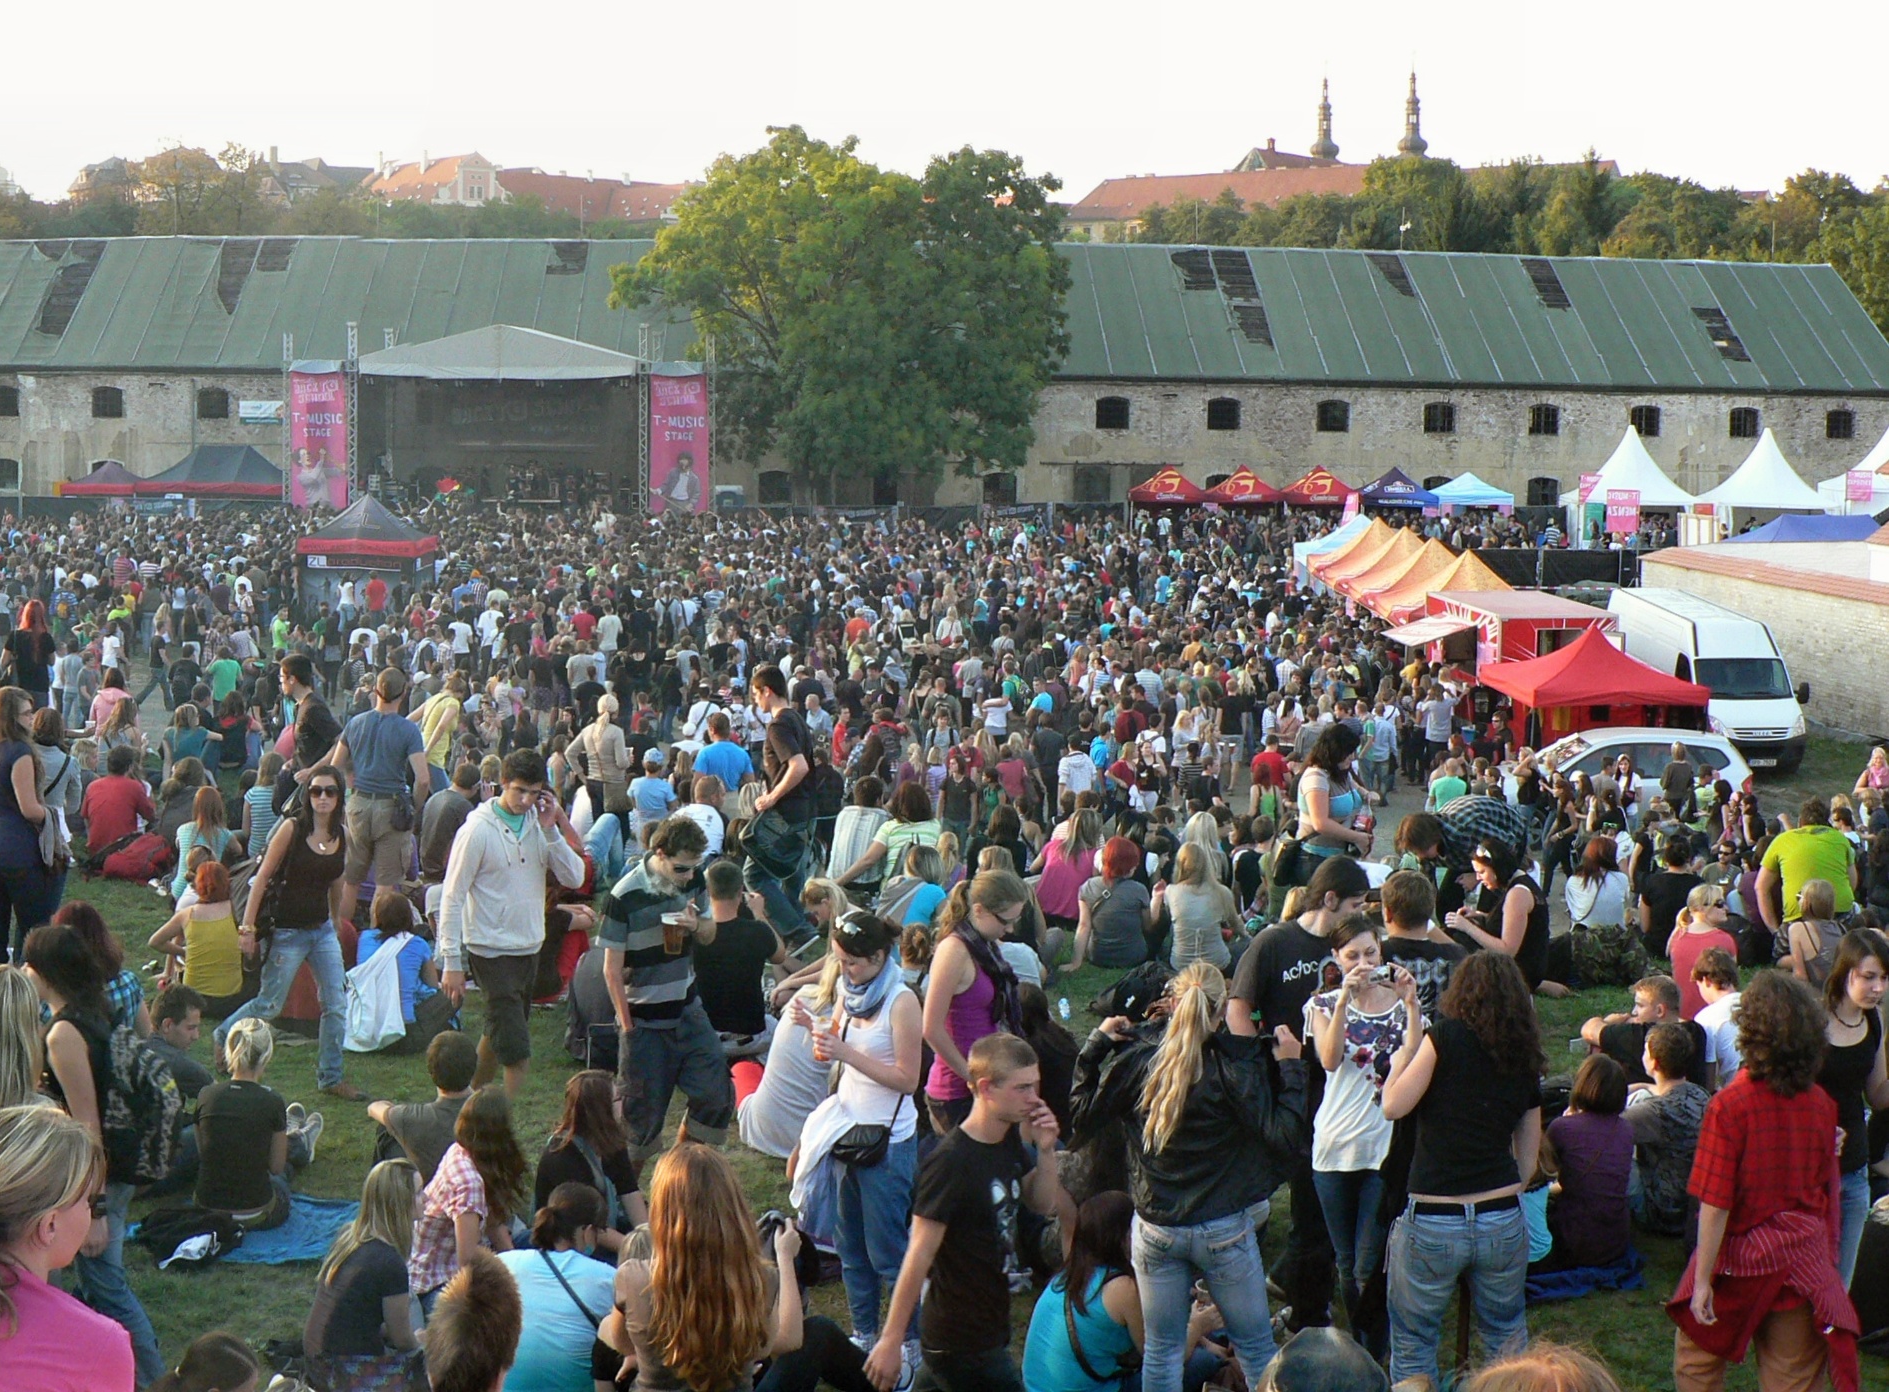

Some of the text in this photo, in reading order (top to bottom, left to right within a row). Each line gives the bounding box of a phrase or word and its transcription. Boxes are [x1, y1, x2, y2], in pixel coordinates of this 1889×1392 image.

[292, 412, 344, 425] T-MUSIC
[653, 414, 706, 428] T-MUSIC
[302, 427, 332, 438] STAGE
[664, 430, 695, 442] STAGE
[308, 556, 327, 567] ZL
[1282, 959, 1320, 983] AC/DC
